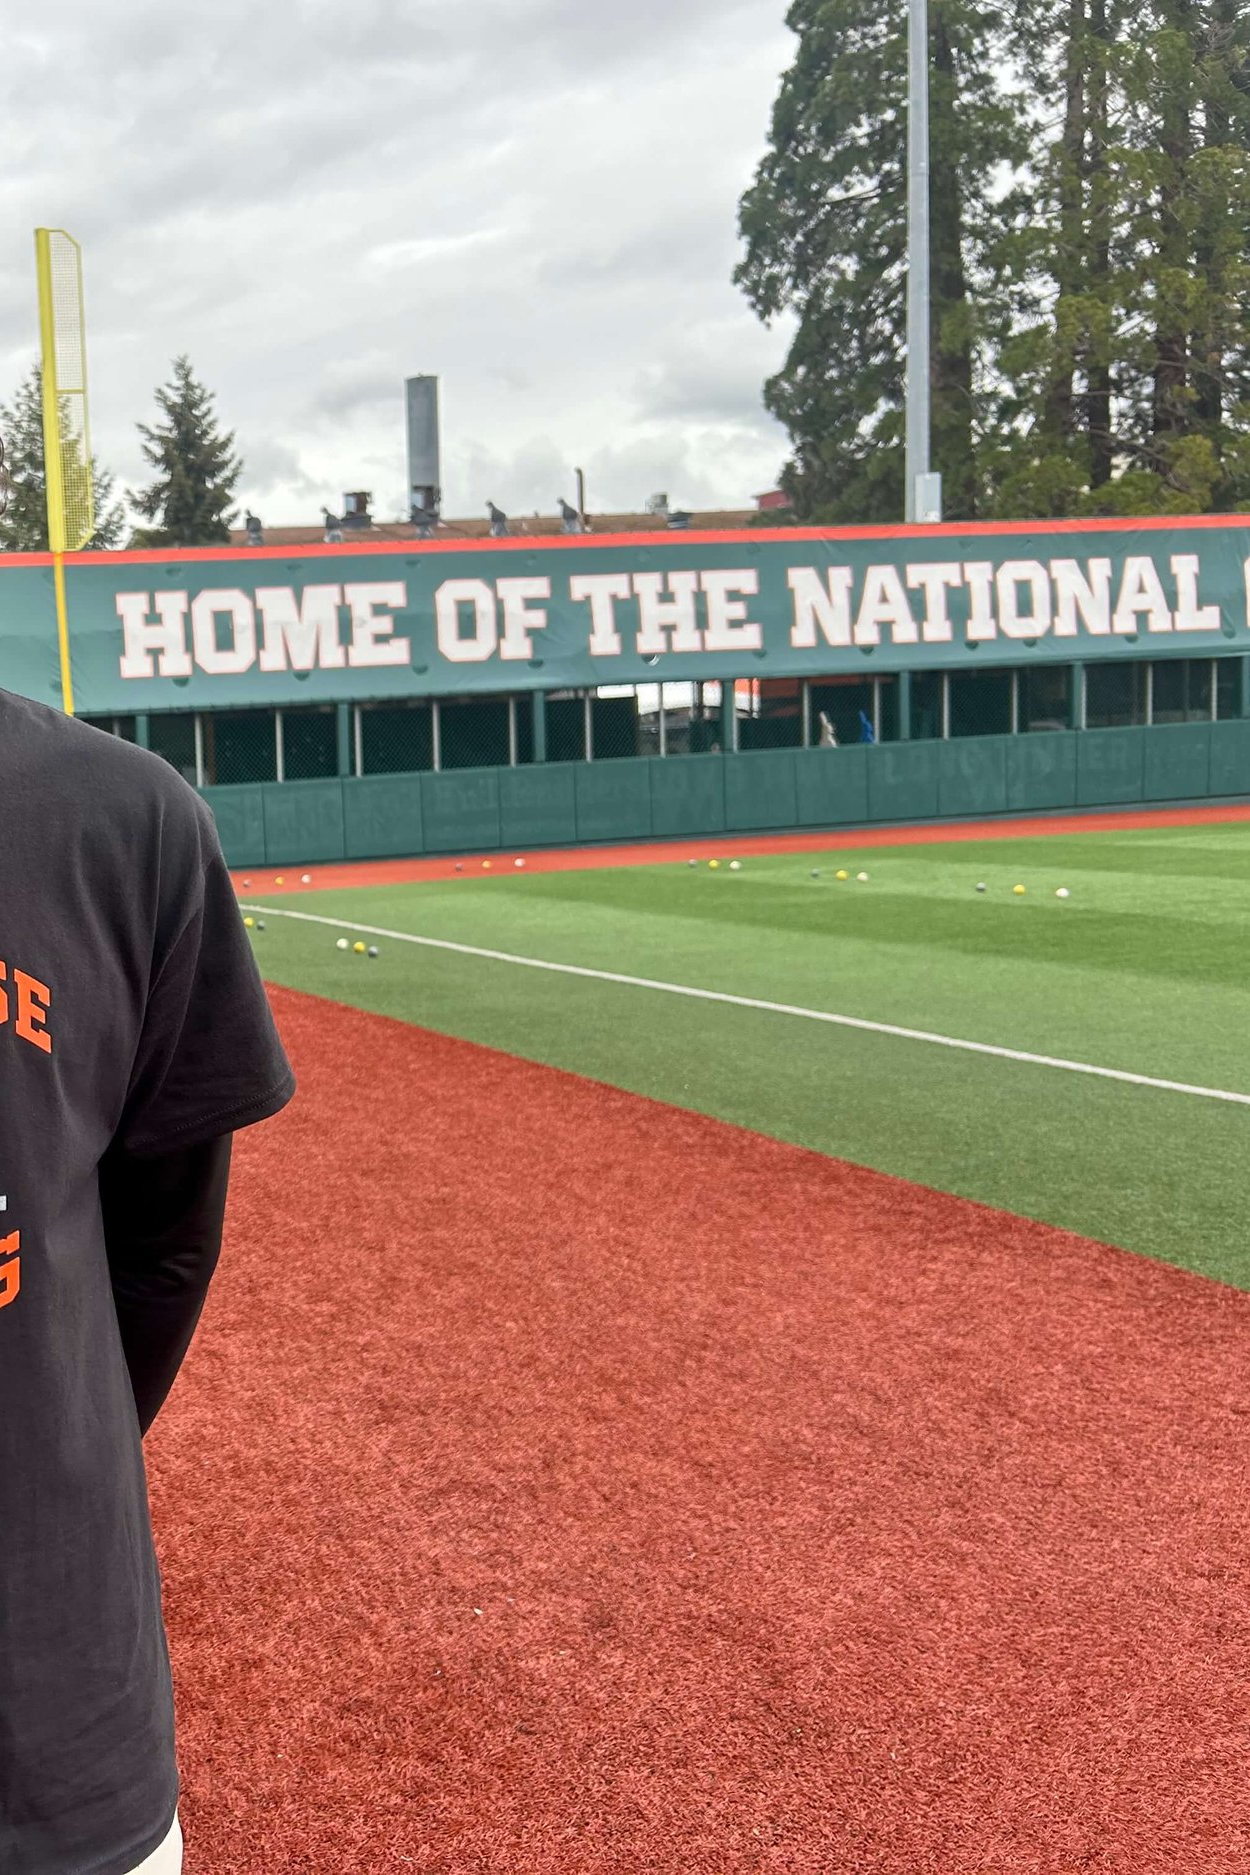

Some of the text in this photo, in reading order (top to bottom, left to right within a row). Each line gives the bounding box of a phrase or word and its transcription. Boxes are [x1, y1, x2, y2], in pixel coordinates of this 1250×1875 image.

[115, 580, 411, 679] HOME
[434, 576, 551, 662] OF
[569, 569, 763, 656] THE
[787, 554, 1221, 648] NATIONAL
